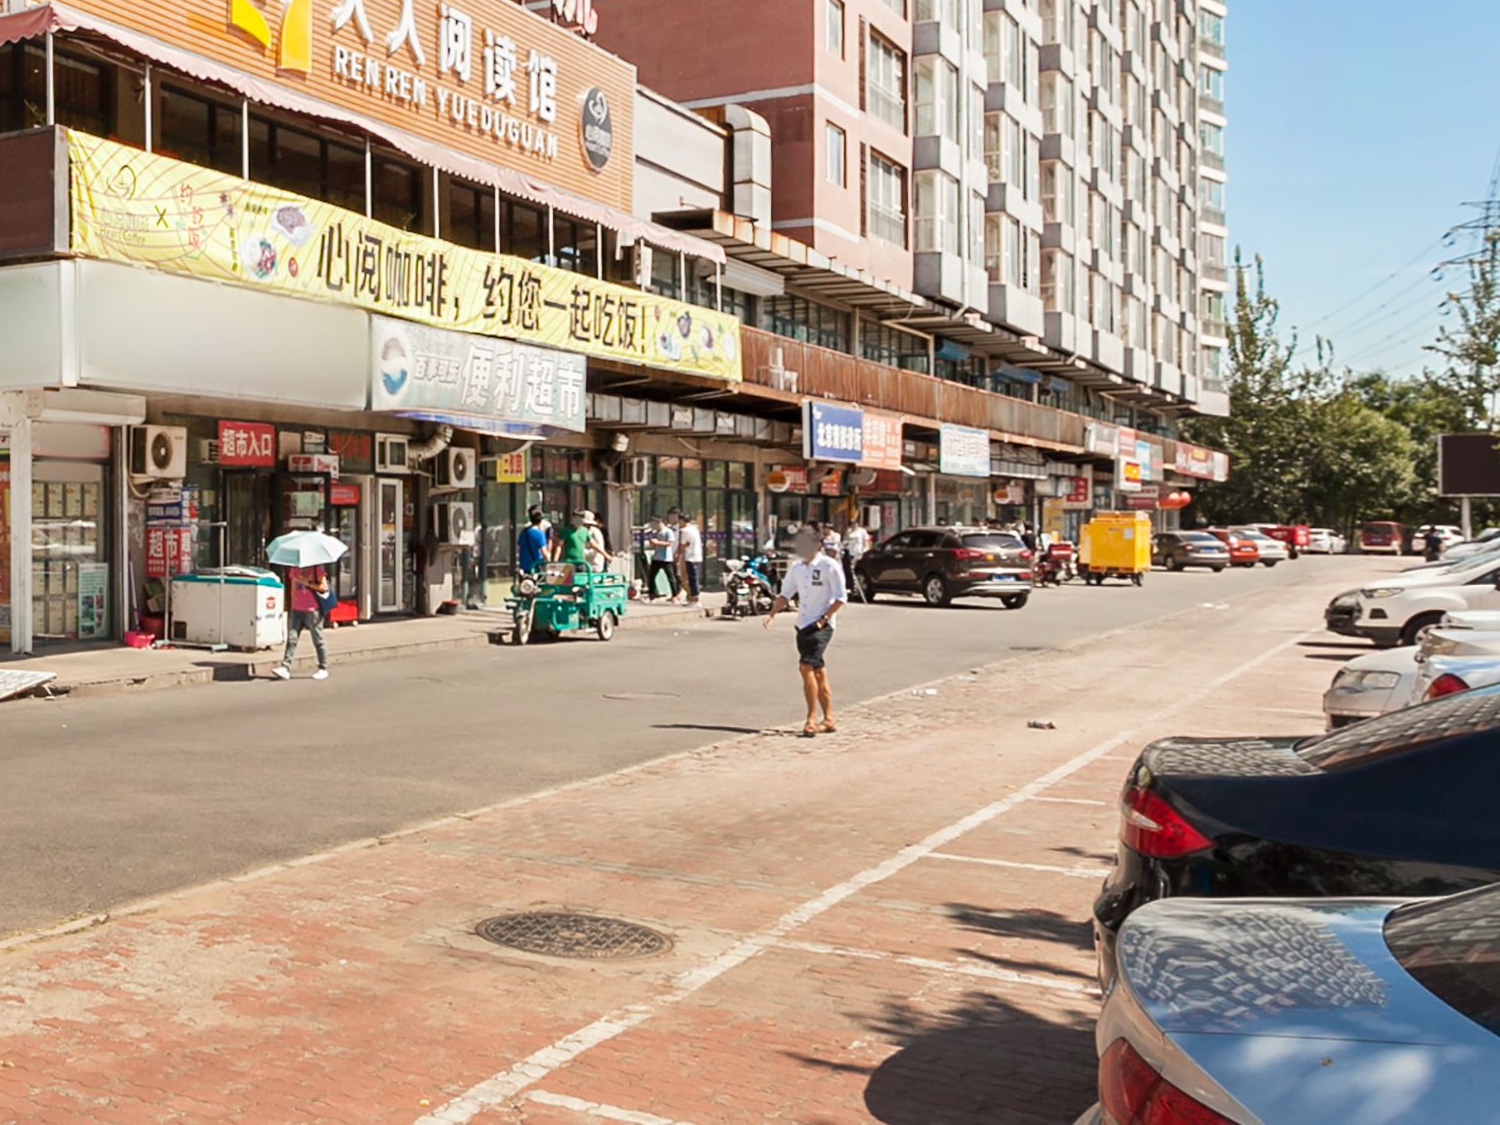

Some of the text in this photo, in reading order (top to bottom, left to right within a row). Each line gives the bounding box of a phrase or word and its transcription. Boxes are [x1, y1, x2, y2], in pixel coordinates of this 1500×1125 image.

[333, 44, 560, 160] RENREN YUEDUGUAN
[461, 342, 583, 419] 便利超市
[221, 428, 272, 457] 超市入口
[148, 530, 179, 558] 超市
